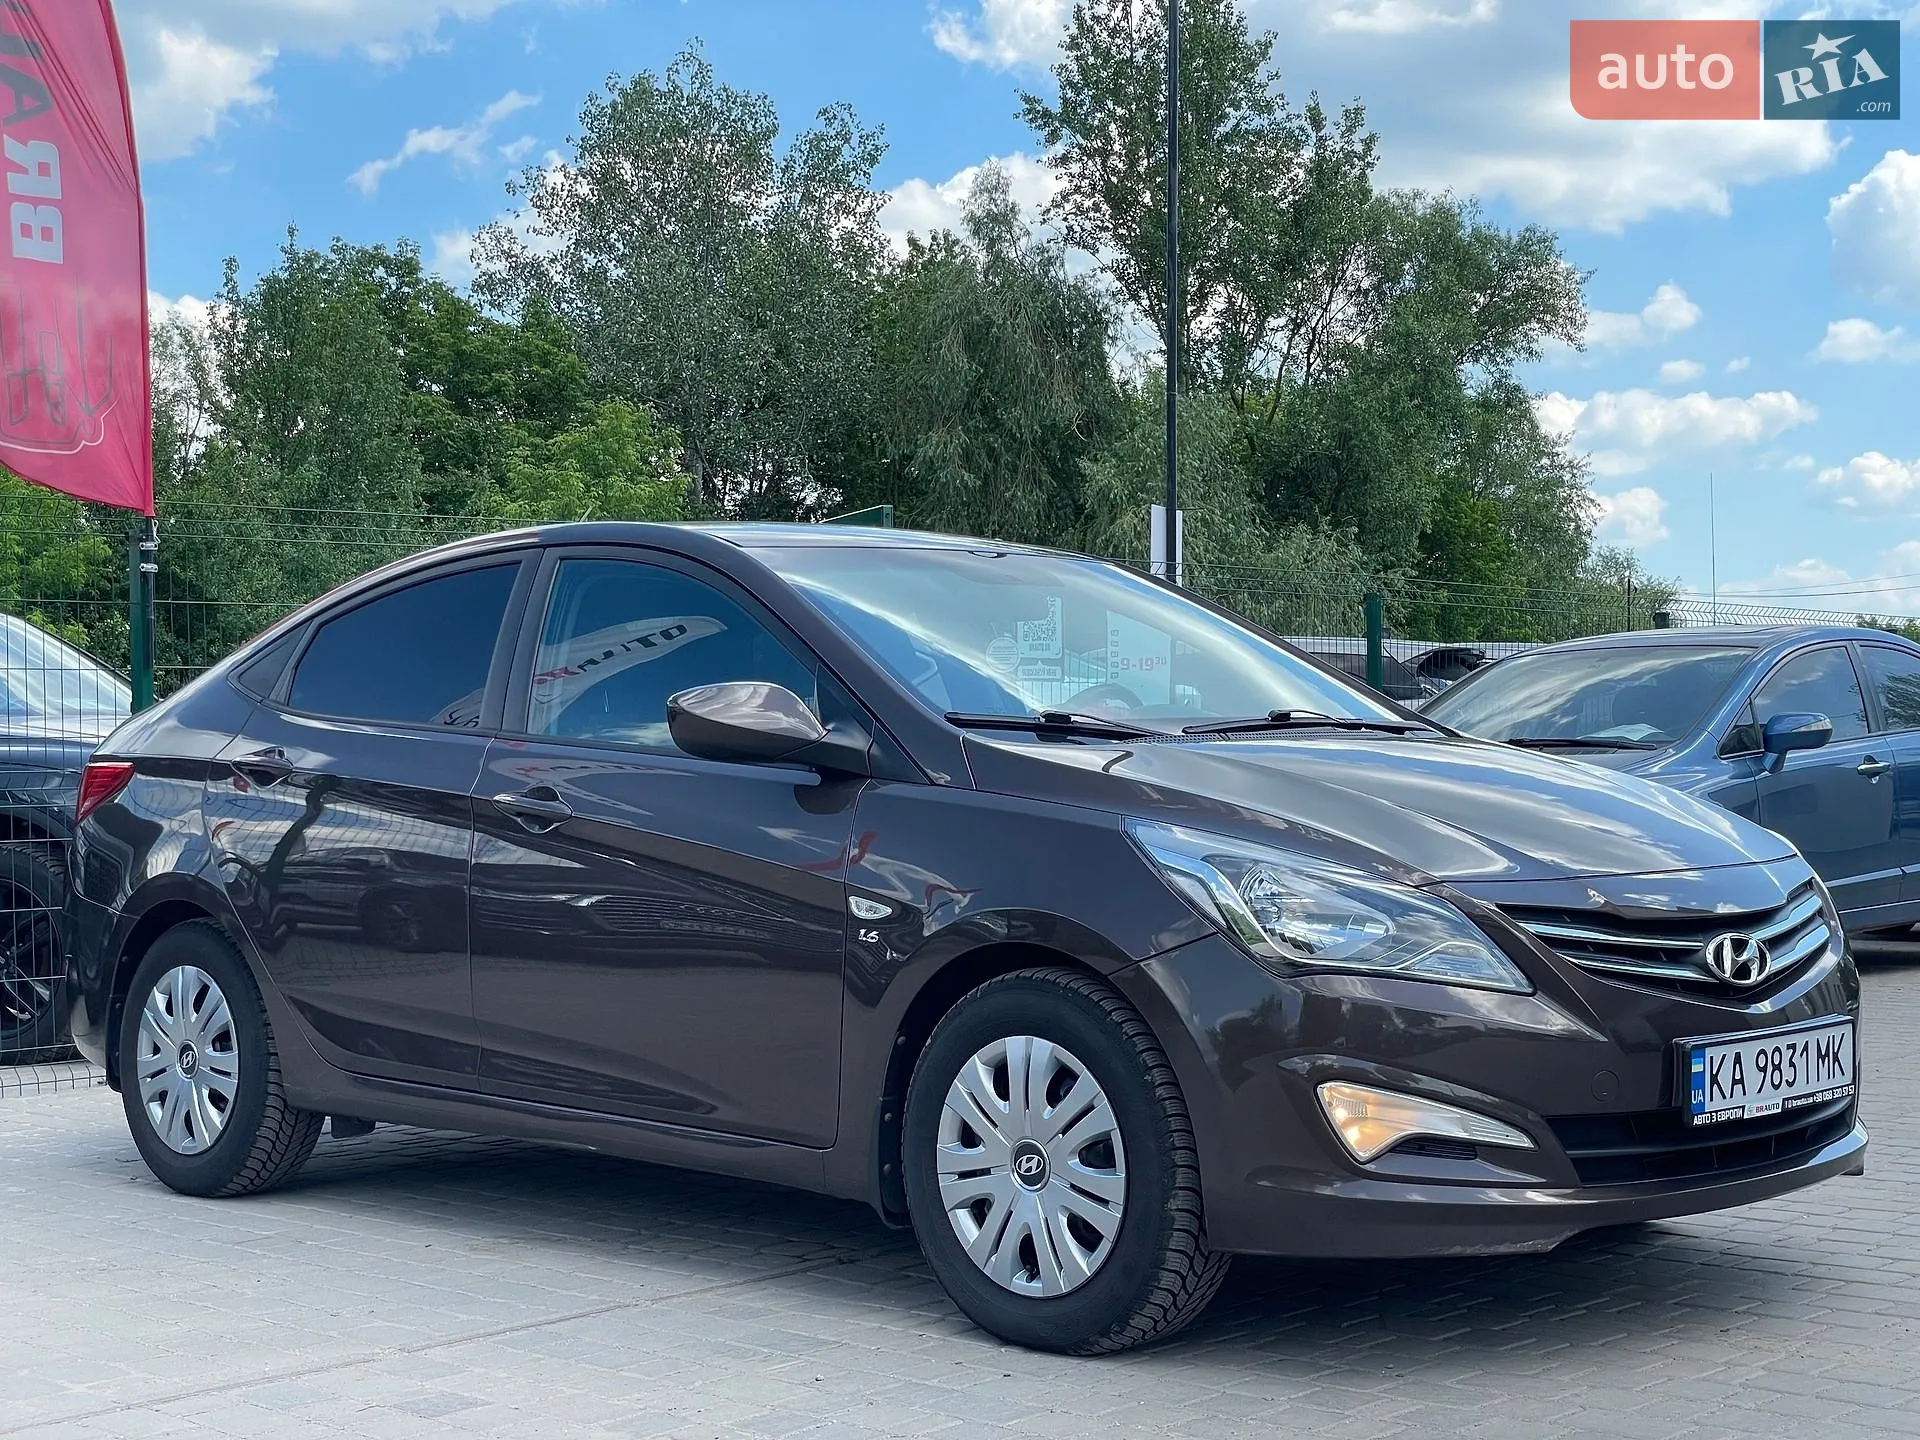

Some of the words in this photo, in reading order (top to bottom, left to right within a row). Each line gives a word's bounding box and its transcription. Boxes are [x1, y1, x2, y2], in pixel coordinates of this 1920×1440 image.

[858, 929, 880, 943] 1.6
[1710, 1051, 1747, 1102] KA
[1755, 1039, 1810, 1094] 9831
[1816, 1032, 1846, 1083] MK
[1691, 1089, 1704, 1105] UA
[1755, 1102, 1780, 1113] BRAUTO
[1692, 1113, 1711, 1126] АВТО
